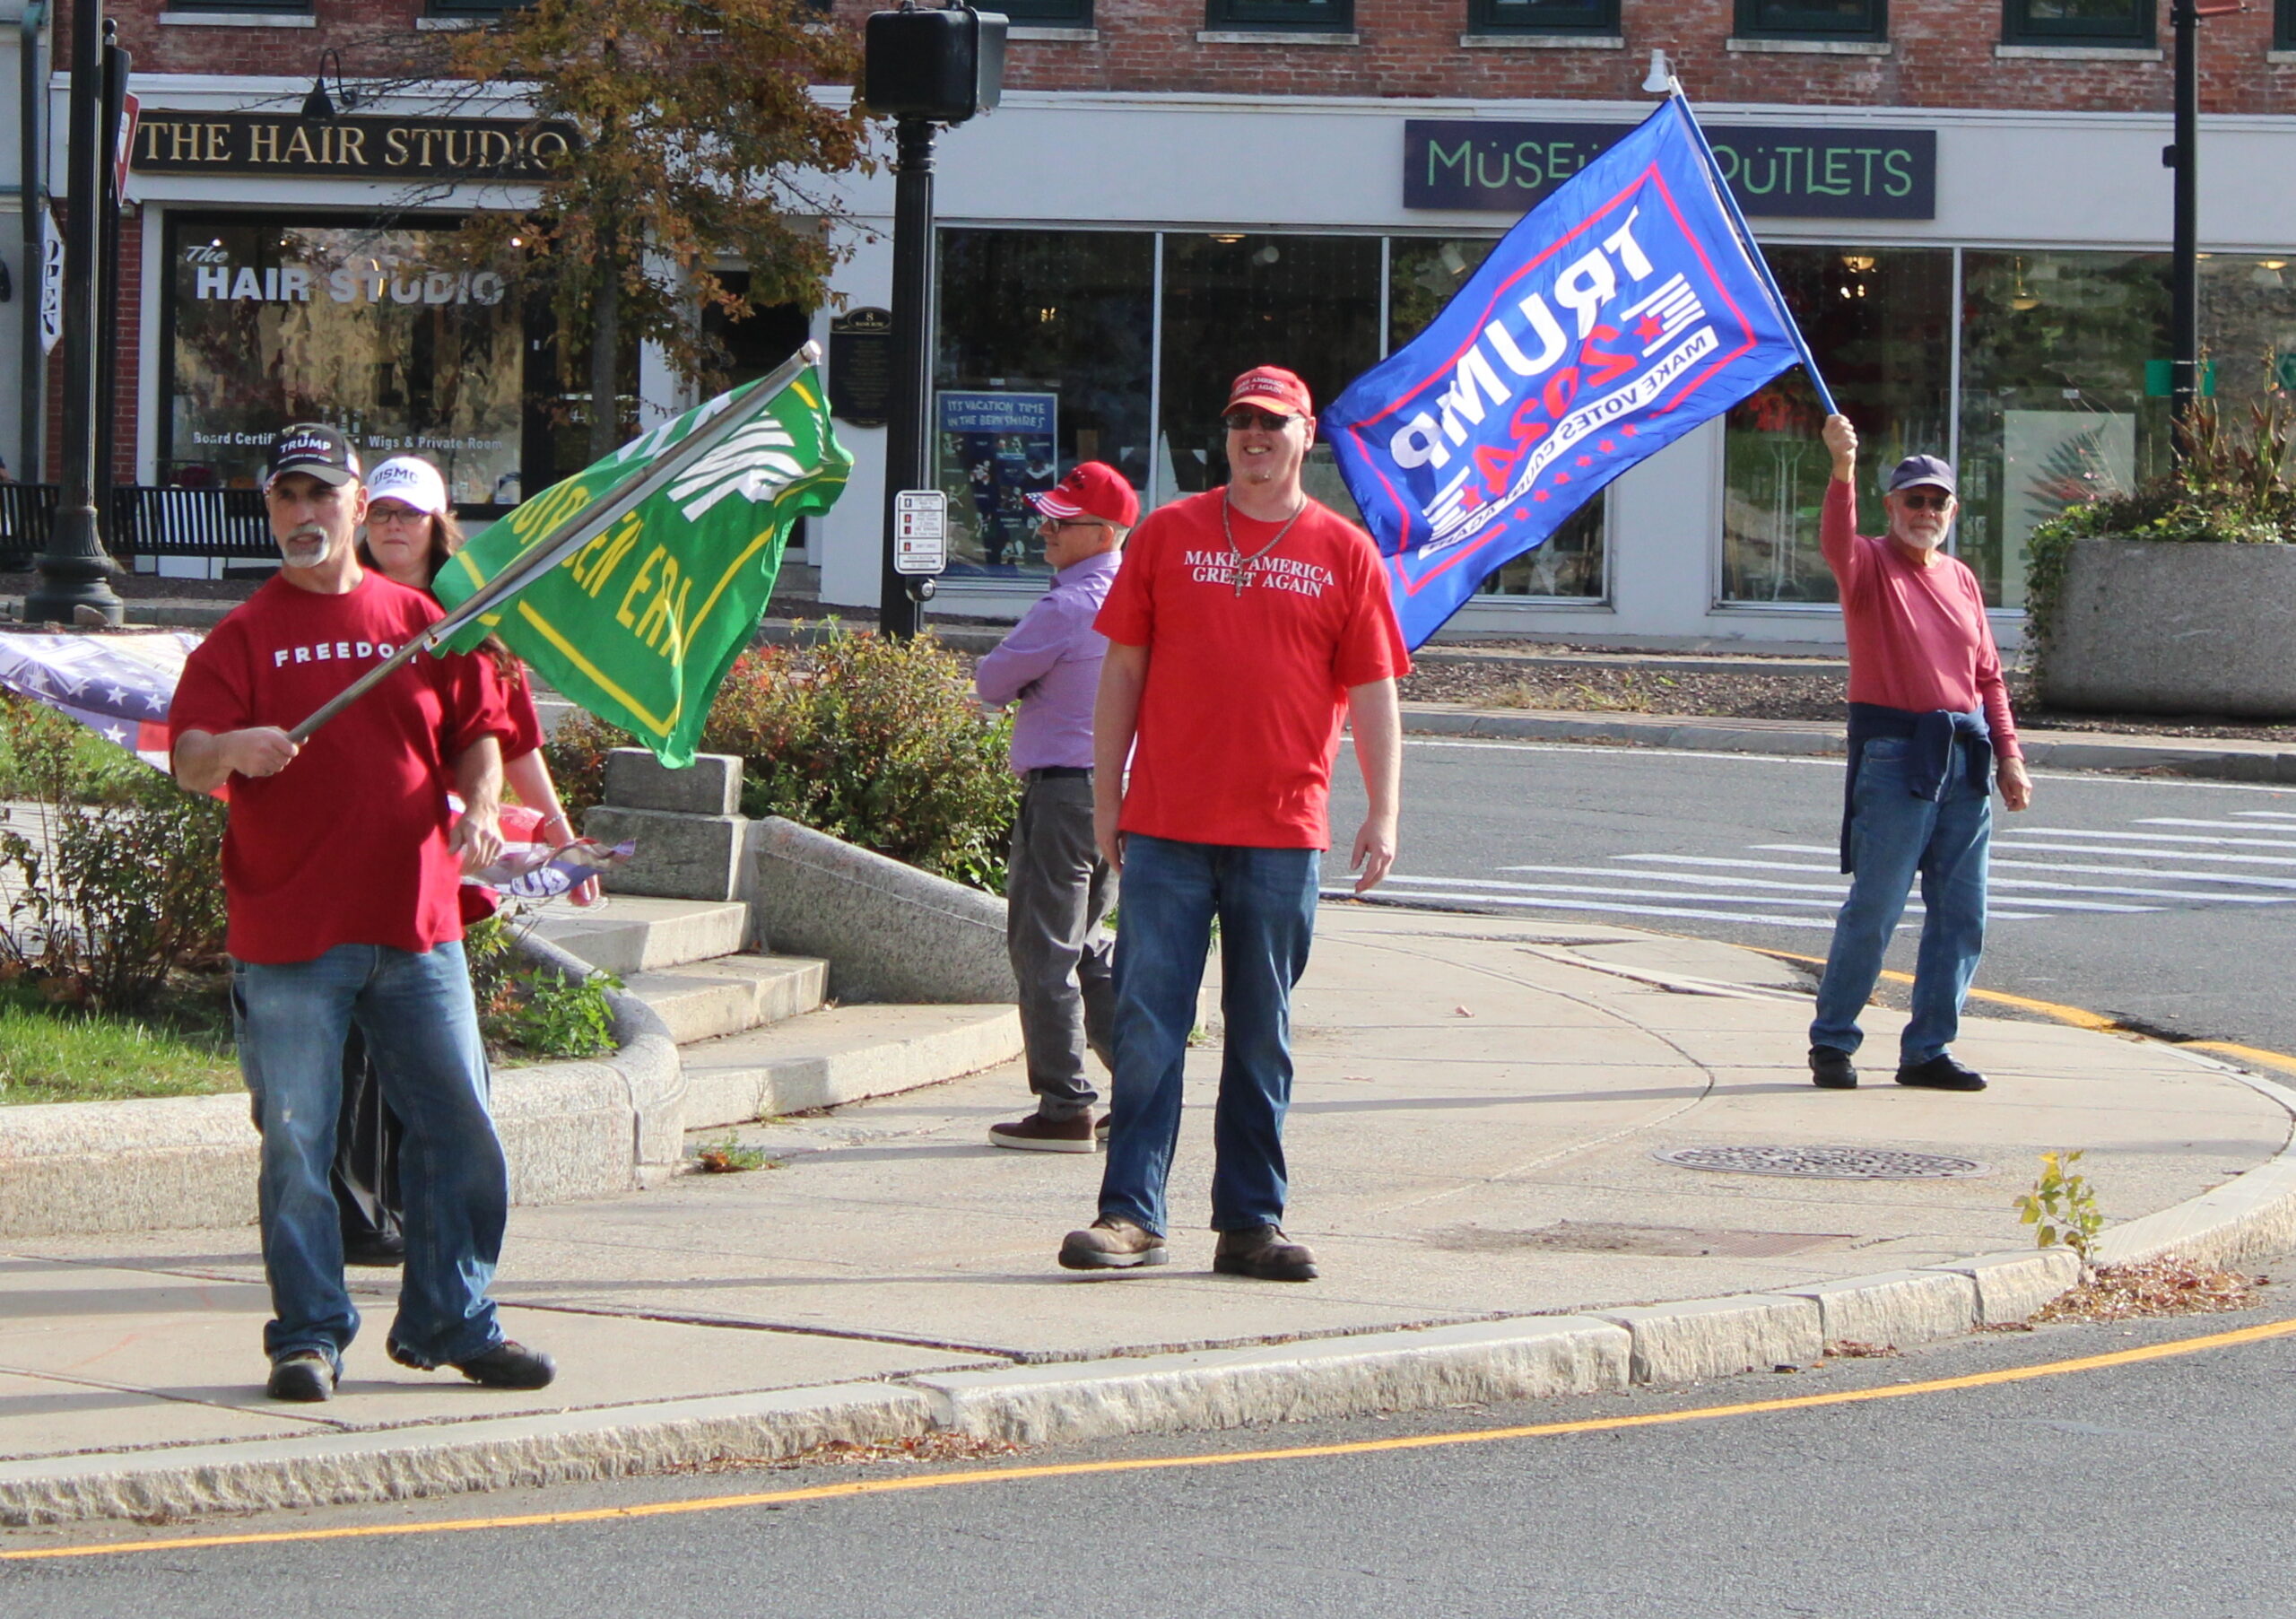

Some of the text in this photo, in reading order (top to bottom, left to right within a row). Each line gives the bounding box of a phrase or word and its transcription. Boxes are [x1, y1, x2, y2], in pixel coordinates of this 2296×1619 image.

[137, 122, 231, 161] THE
[248, 124, 369, 165] HAIR
[385, 127, 569, 170] STUDIO
[186, 246, 229, 263] The
[196, 265, 505, 306] HAIR STUDIO
[965, 400, 1013, 413] VACATION
[1019, 403, 1046, 414] TIME
[960, 415, 977, 426] THE
[193, 431, 230, 445] Board
[369, 435, 400, 450] Wigs
[404, 436, 413, 448] &
[418, 436, 463, 448] Private
[468, 437, 503, 449] Room
[280, 438, 332, 454] TRUMP
[373, 466, 418, 486] USMC
[1184, 550, 1335, 586] MAKE AMERICA
[1262, 574, 1323, 598] AGAIN
[274, 641, 417, 667] FREEDO
